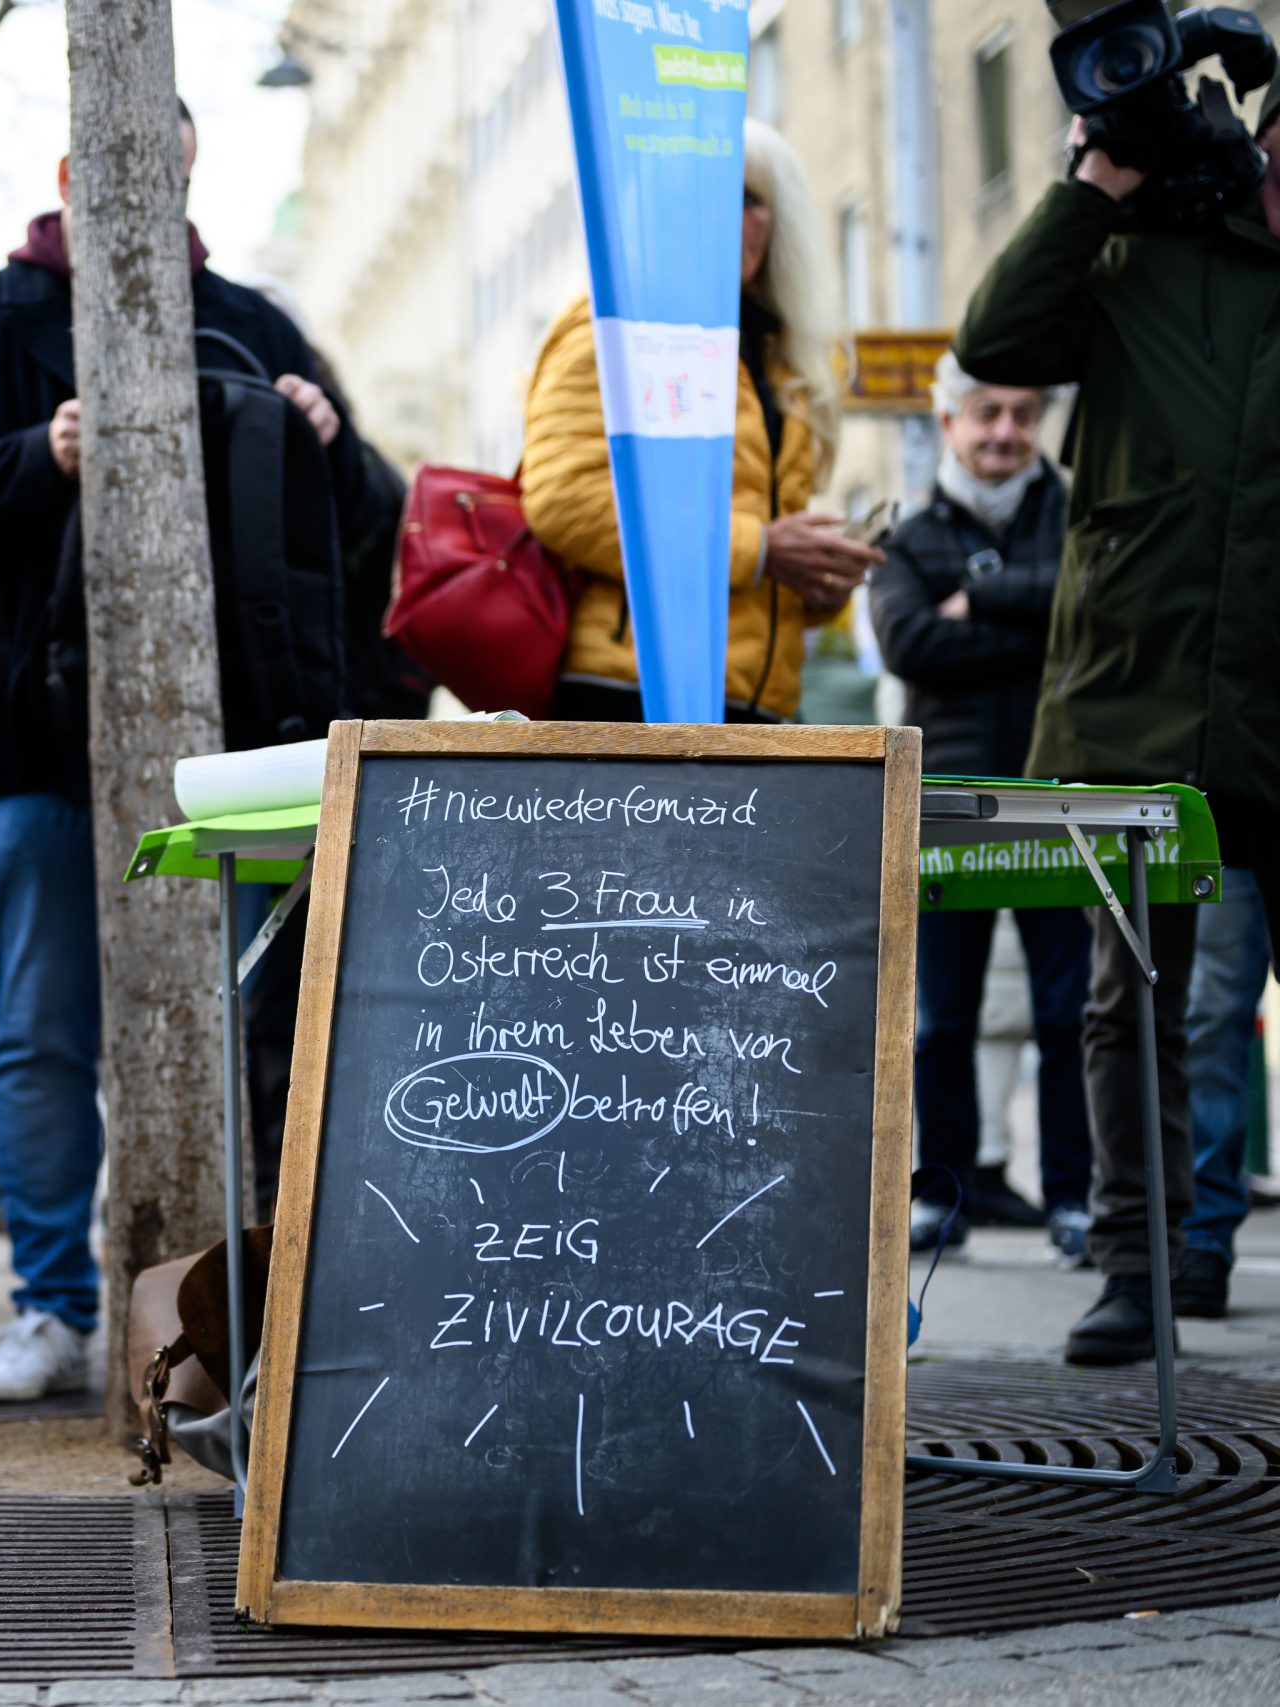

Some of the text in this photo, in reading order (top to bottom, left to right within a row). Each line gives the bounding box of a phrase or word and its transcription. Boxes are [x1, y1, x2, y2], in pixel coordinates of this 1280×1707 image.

[398, 776, 759, 827] #niewiederfemizid
[417, 864, 517, 923] Jede
[595, 870, 698, 919] Frau
[727, 888, 767, 926] in
[417, 926, 838, 1008] Österreich ist einmal
[415, 997, 802, 1074] in ihrem Leben von
[401, 1070, 553, 1125] Gewalt
